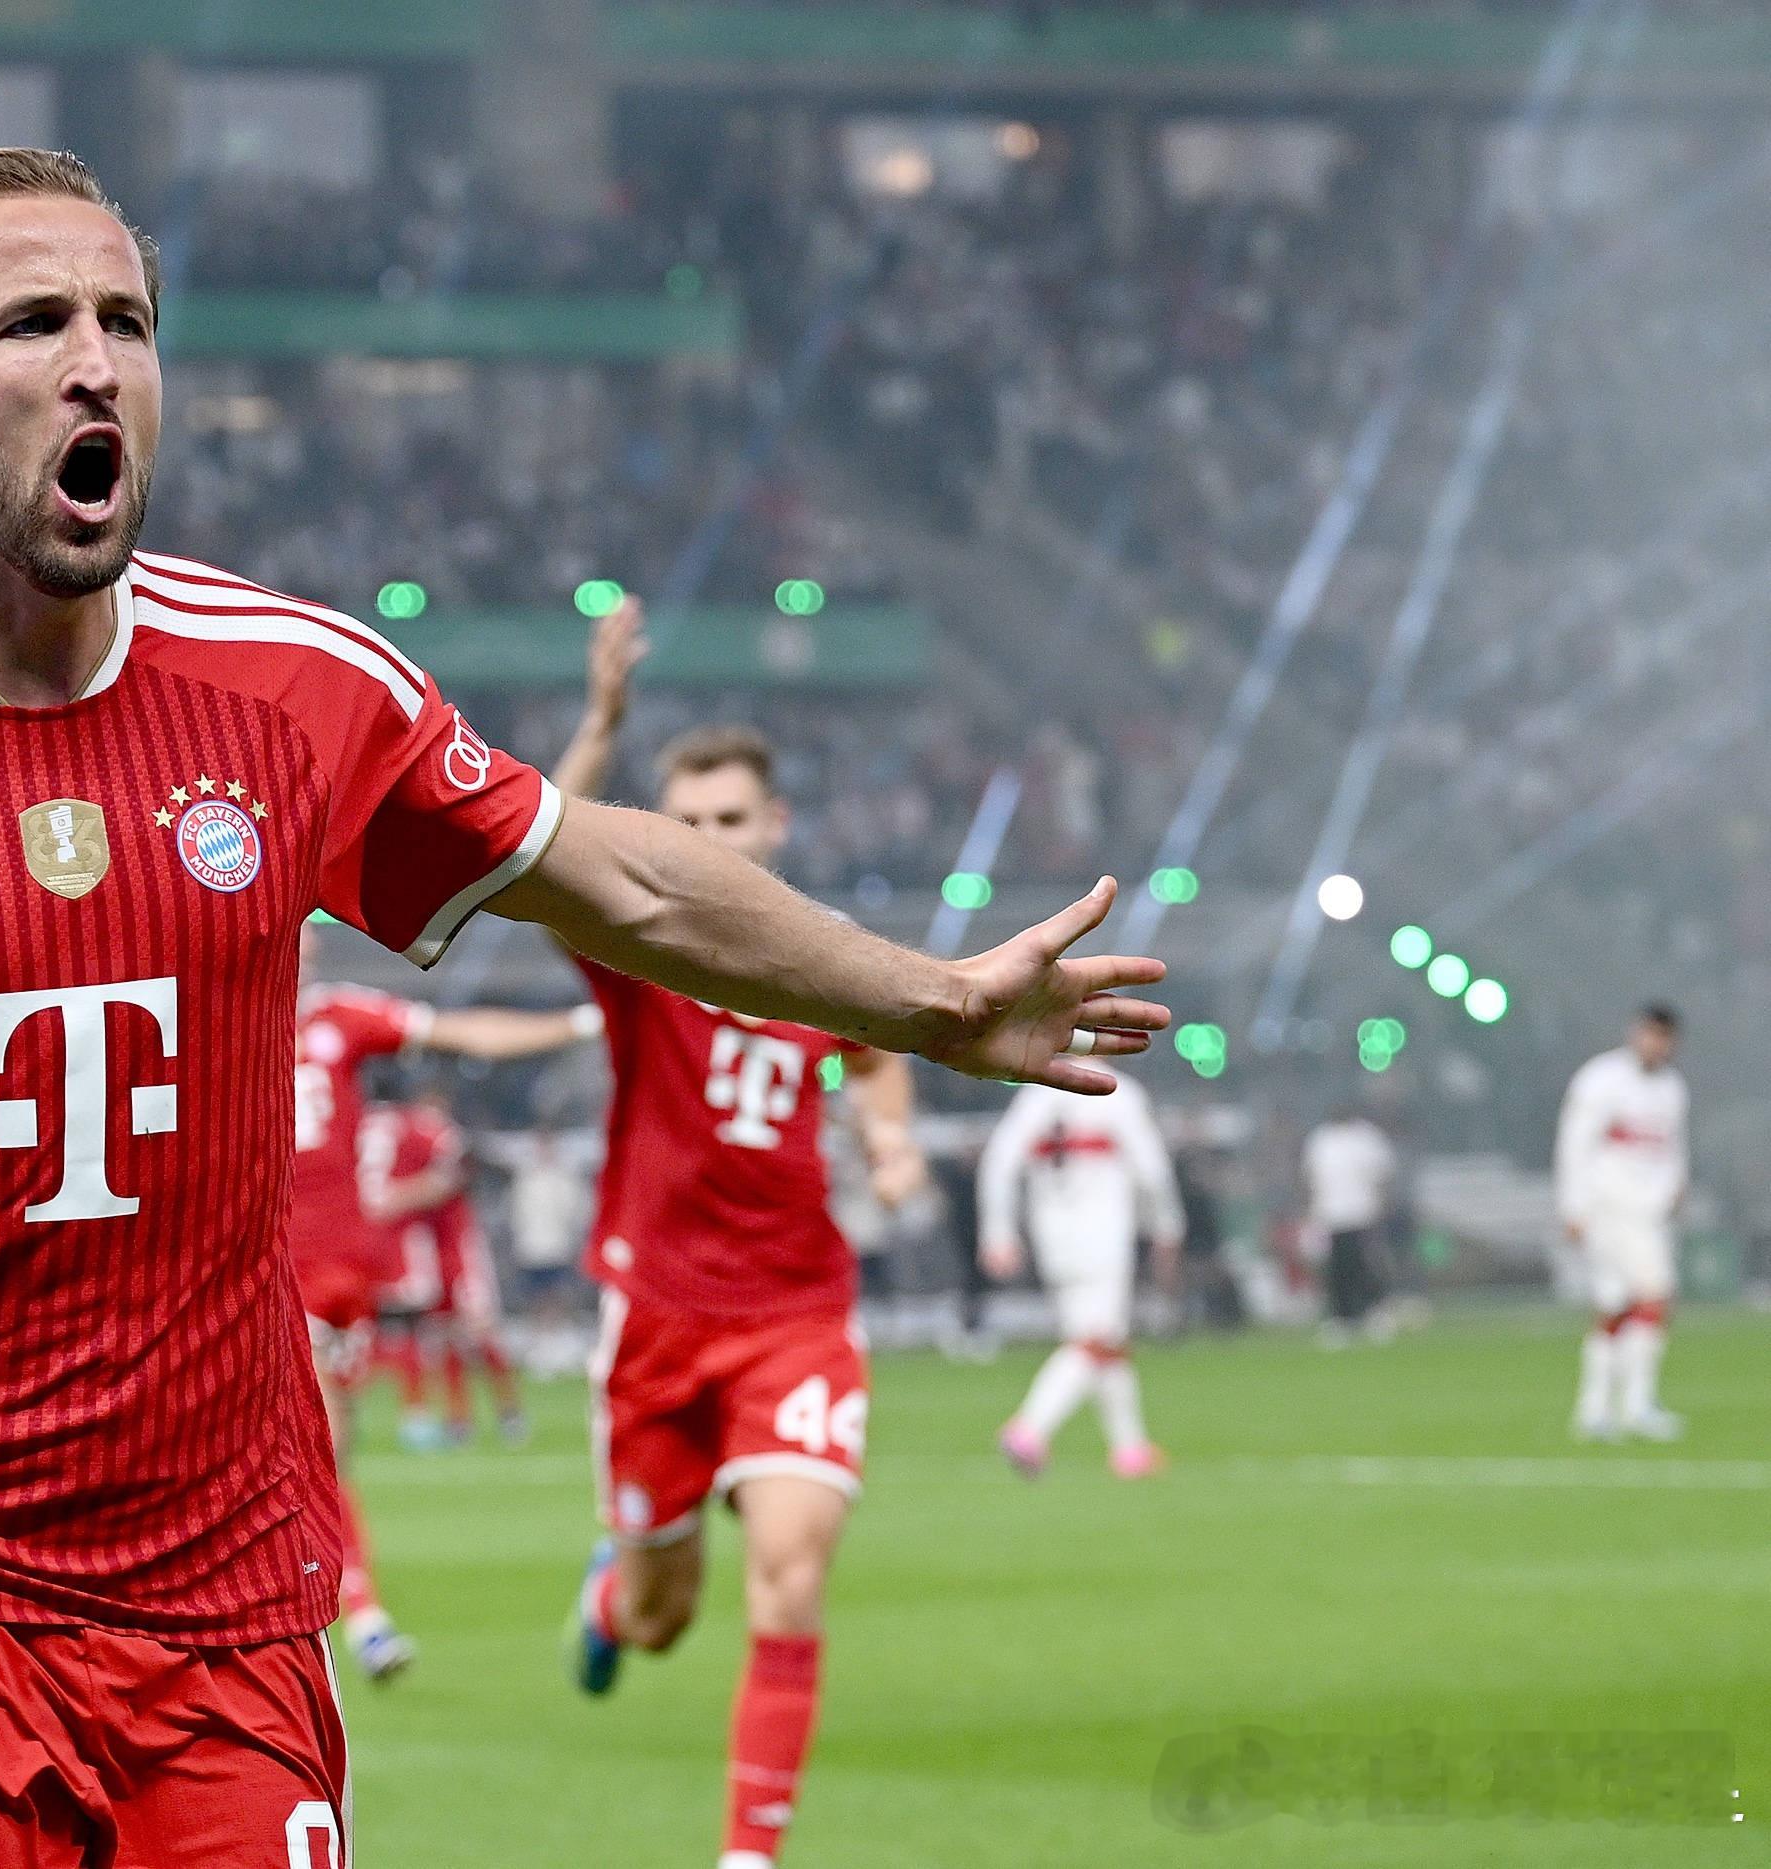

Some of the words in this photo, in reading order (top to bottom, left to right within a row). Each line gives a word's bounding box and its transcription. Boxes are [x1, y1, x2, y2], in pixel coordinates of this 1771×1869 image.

[185, 821, 198, 840] FC
[195, 807, 251, 839] BAYERN
[706, 1027, 802, 1148] T
